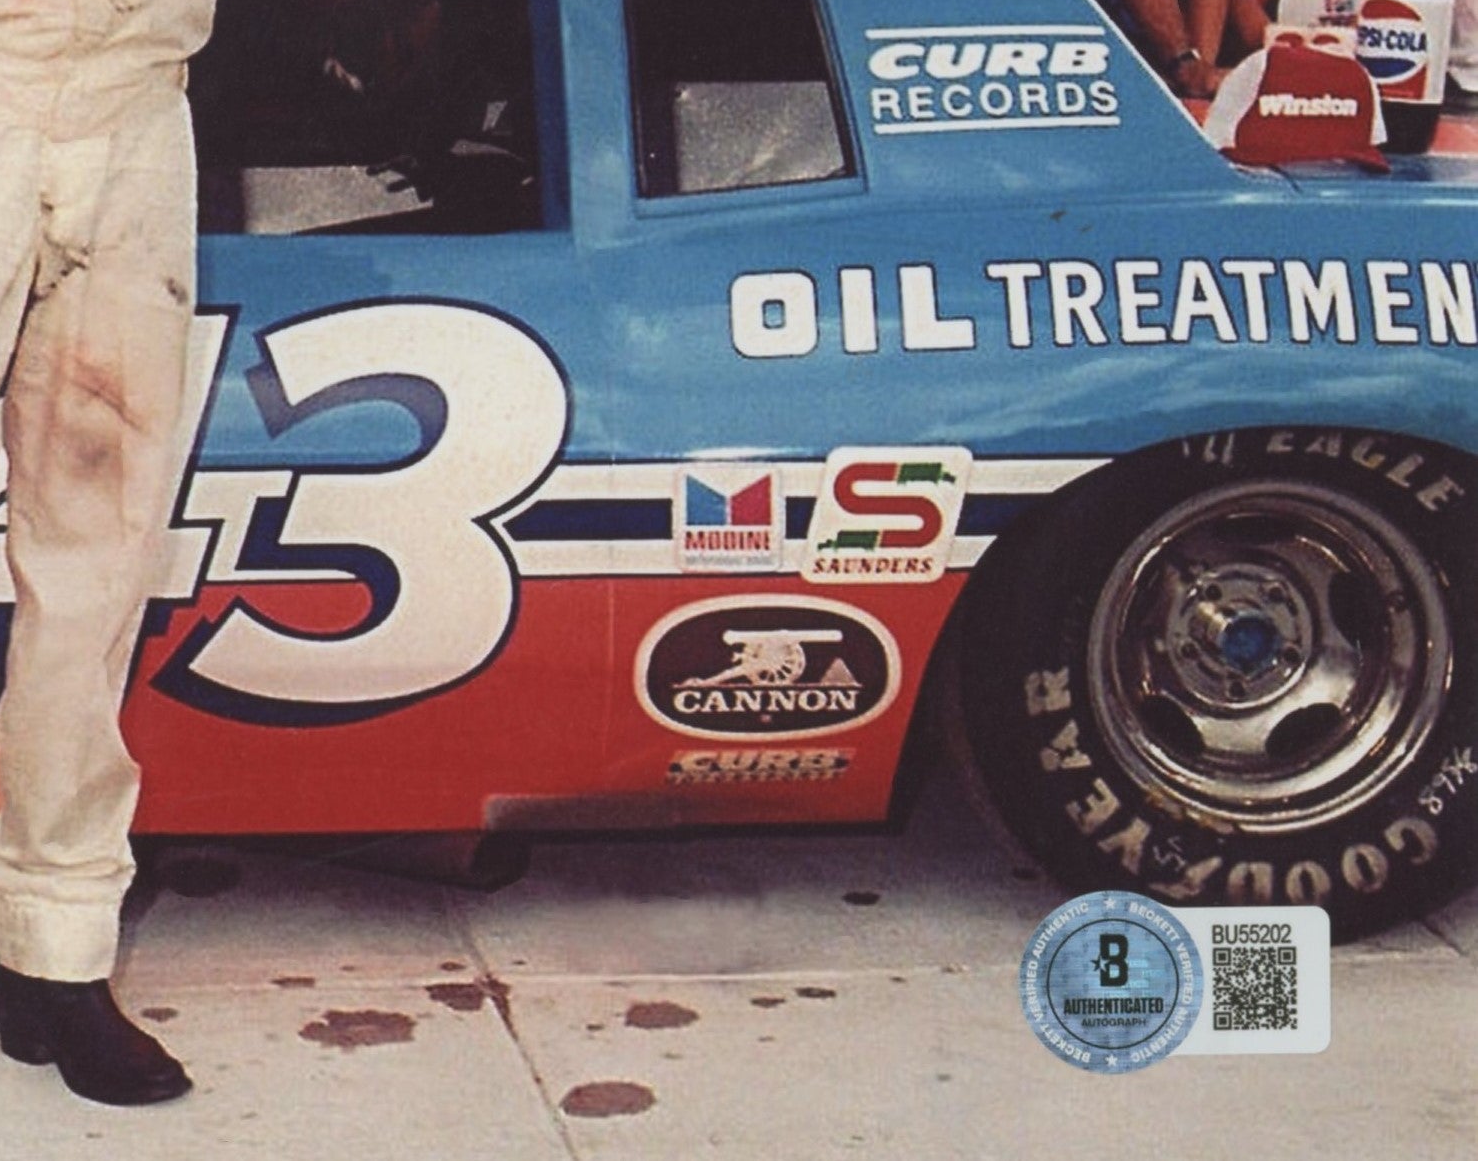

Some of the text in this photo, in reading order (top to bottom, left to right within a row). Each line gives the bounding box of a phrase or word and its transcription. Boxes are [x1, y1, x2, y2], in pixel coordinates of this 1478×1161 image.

[868, 41, 1109, 79] CURB
[870, 80, 1120, 122] RECORDS
[1259, 92, 1358, 117] Winston
[729, 258, 1478, 359] OIL TREATMEN
[811, 556, 934, 575] SAUNDERS
[672, 688, 859, 713] CANNON
